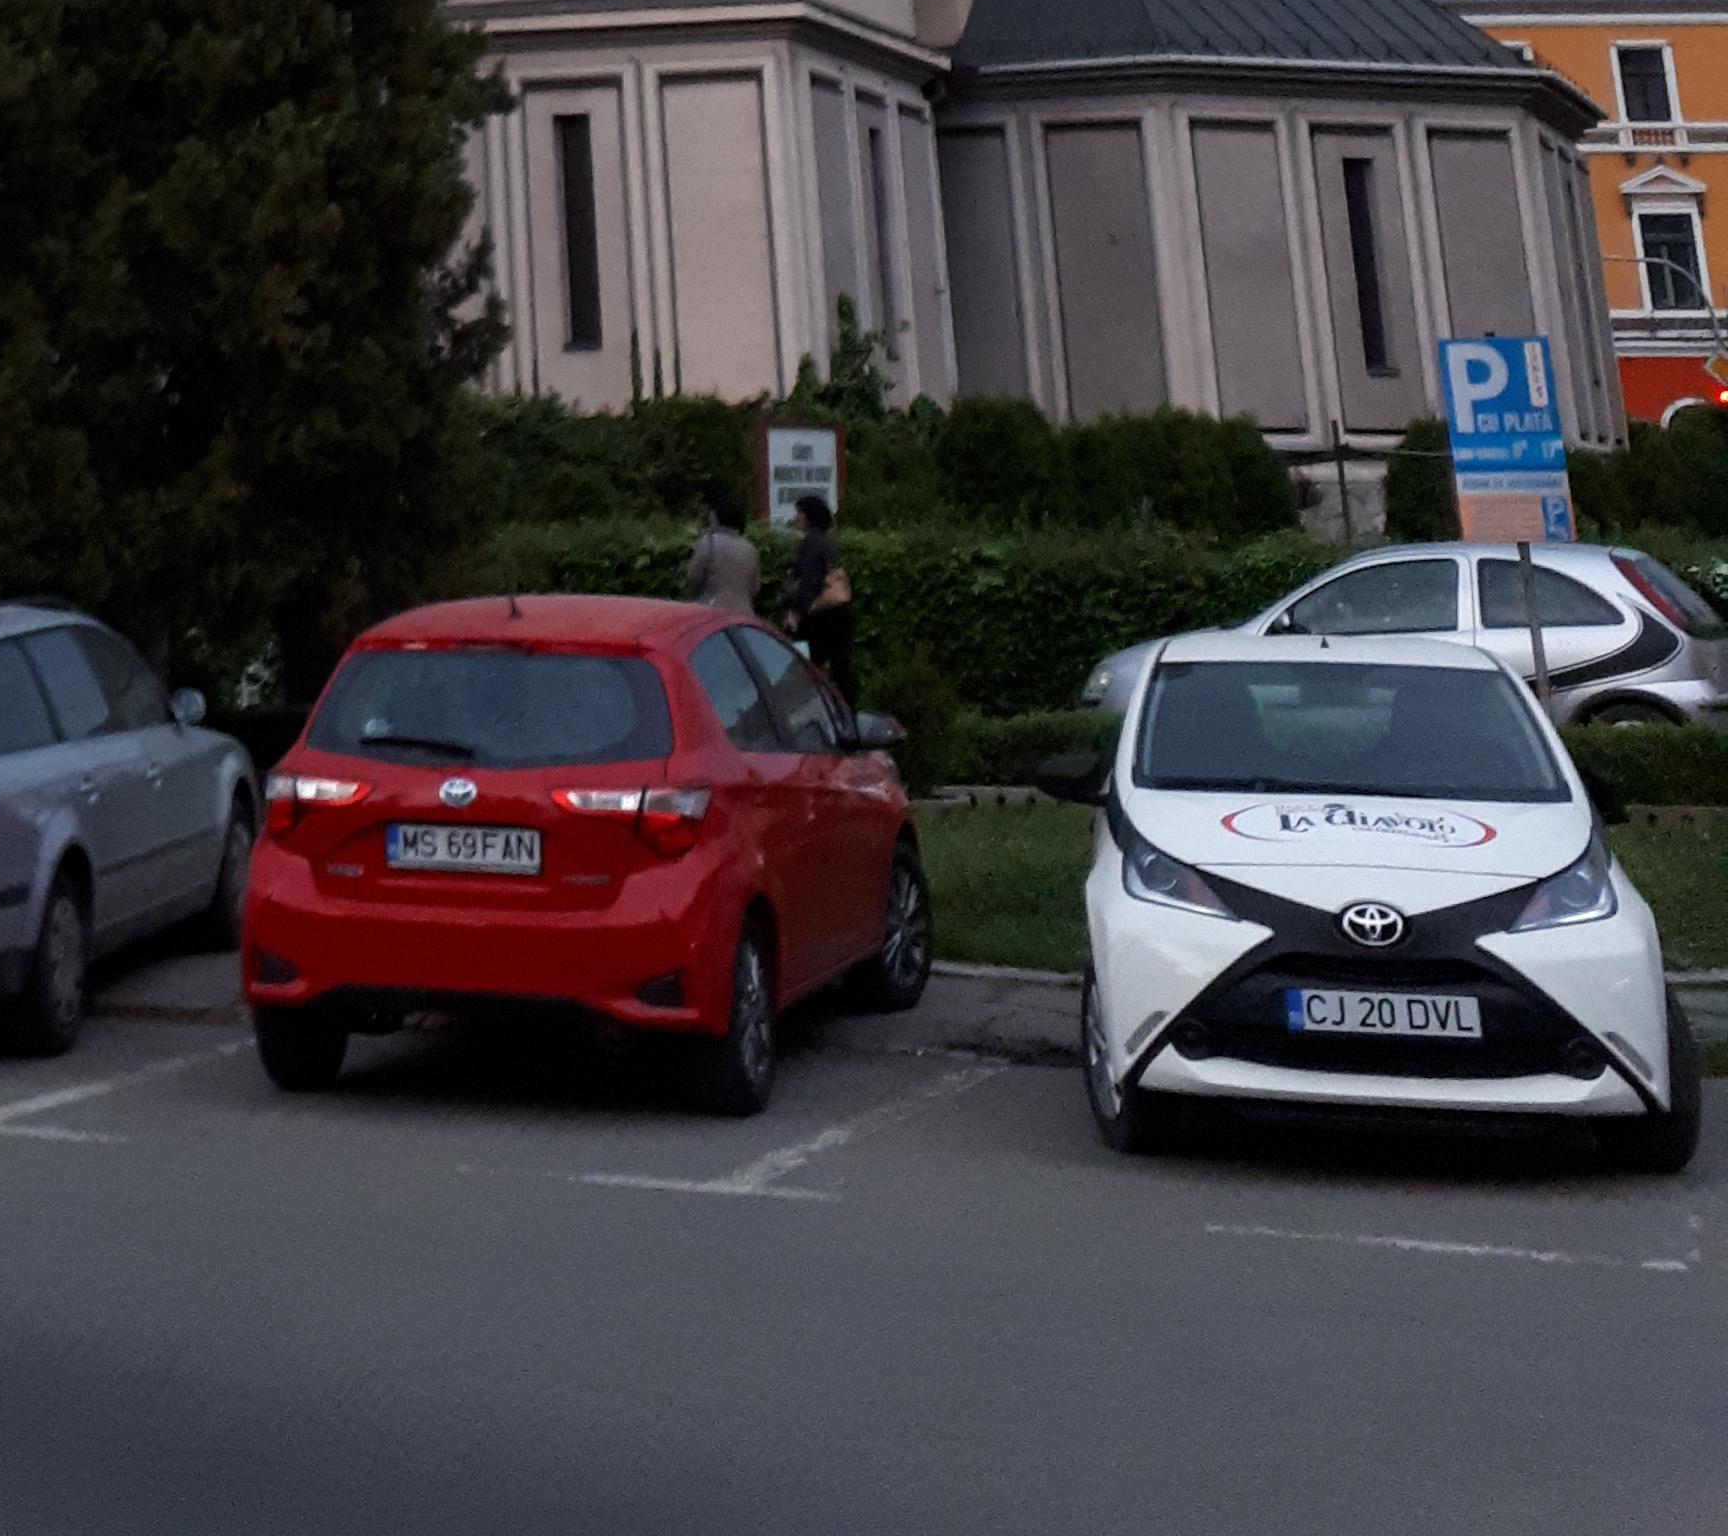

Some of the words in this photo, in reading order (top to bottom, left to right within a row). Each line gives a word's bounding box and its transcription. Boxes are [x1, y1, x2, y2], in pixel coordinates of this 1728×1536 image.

[1446, 342, 1509, 434] P
[402, 828, 438, 858] MS
[1306, 994, 1346, 1026] CJ
[1358, 997, 1396, 1029] 20
[1406, 999, 1474, 1032] DVL
